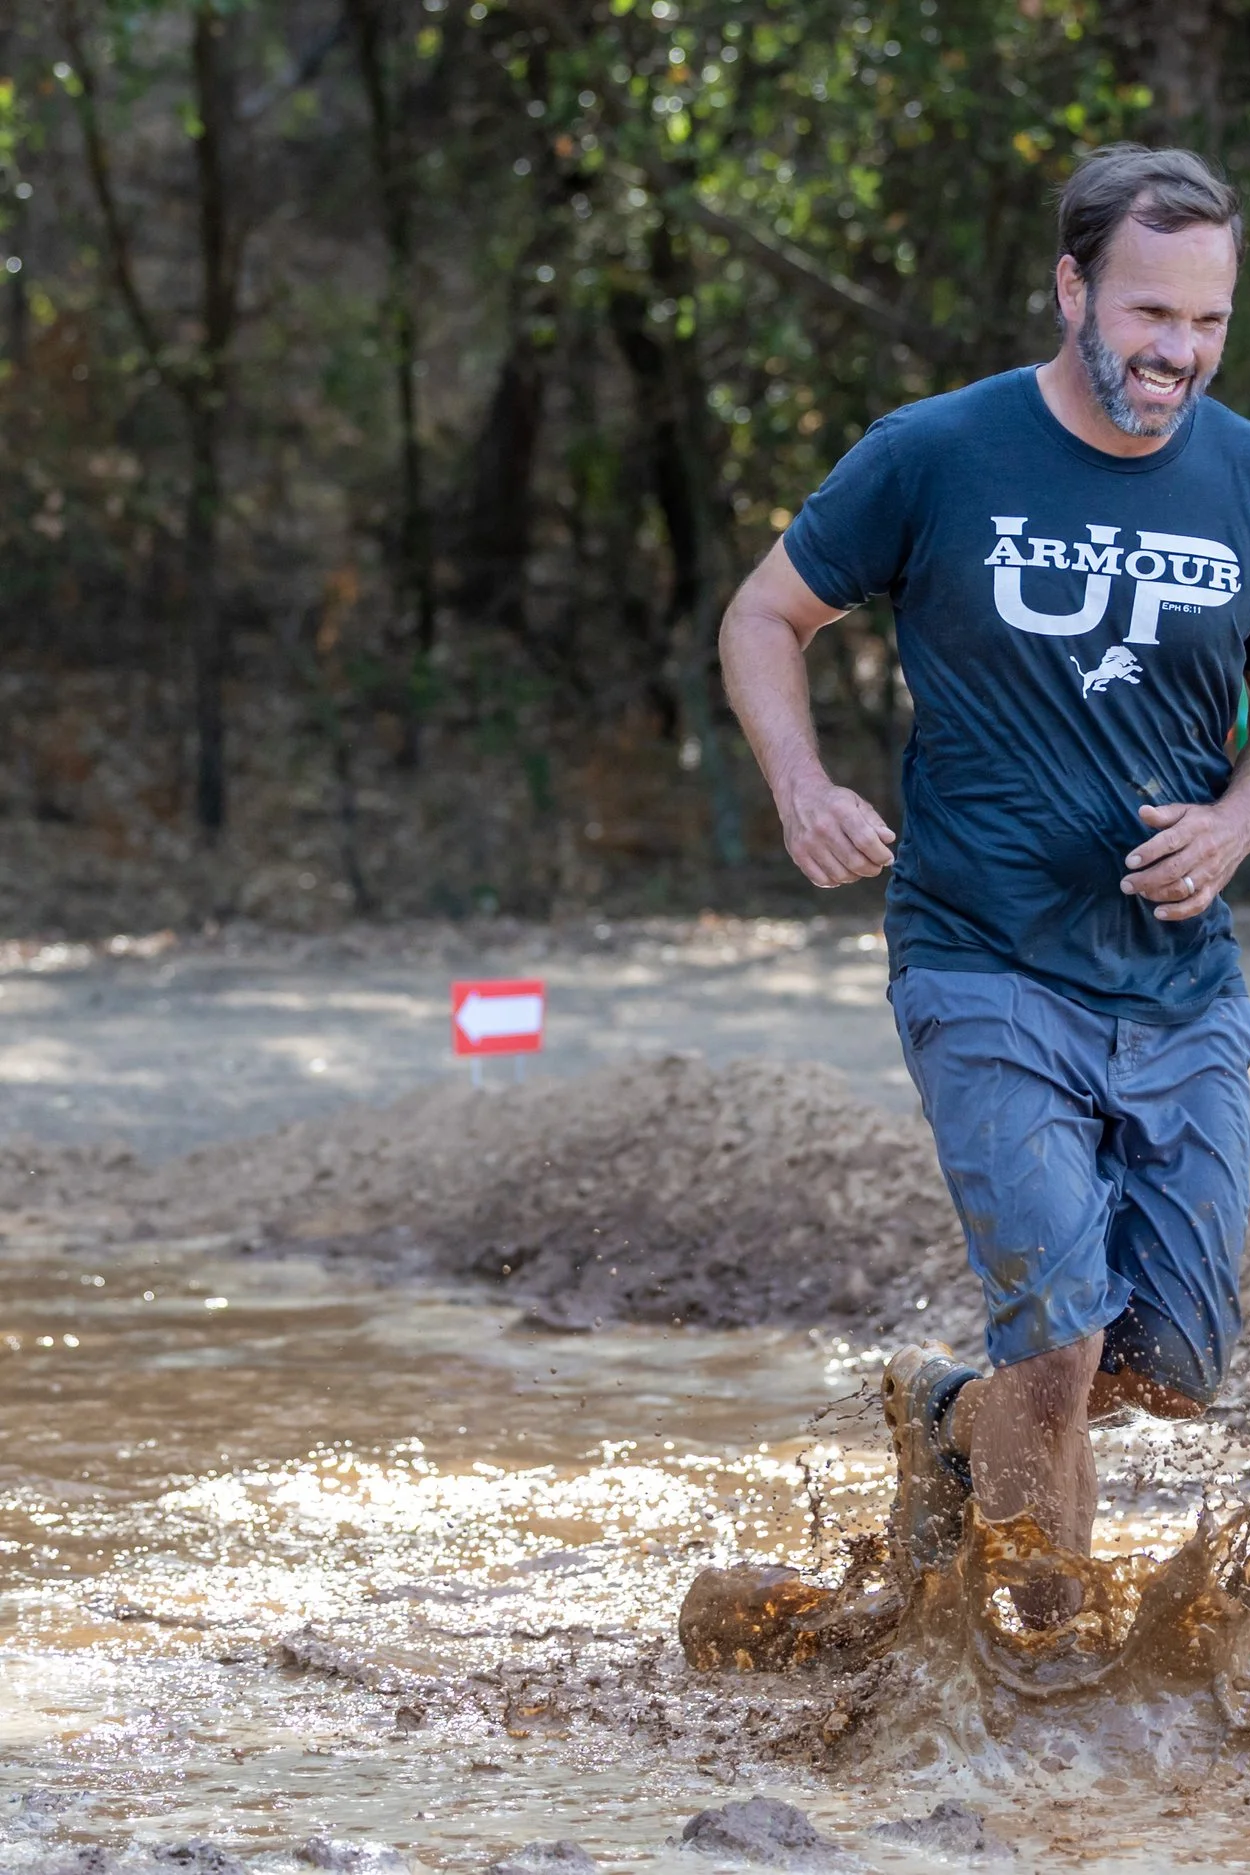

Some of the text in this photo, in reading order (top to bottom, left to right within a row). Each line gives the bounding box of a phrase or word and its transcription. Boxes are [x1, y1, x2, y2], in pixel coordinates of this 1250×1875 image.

[984, 536, 1242, 593] ARMOUR
[990, 516, 1238, 645] UP
[1183, 604, 1201, 614] 6:11
